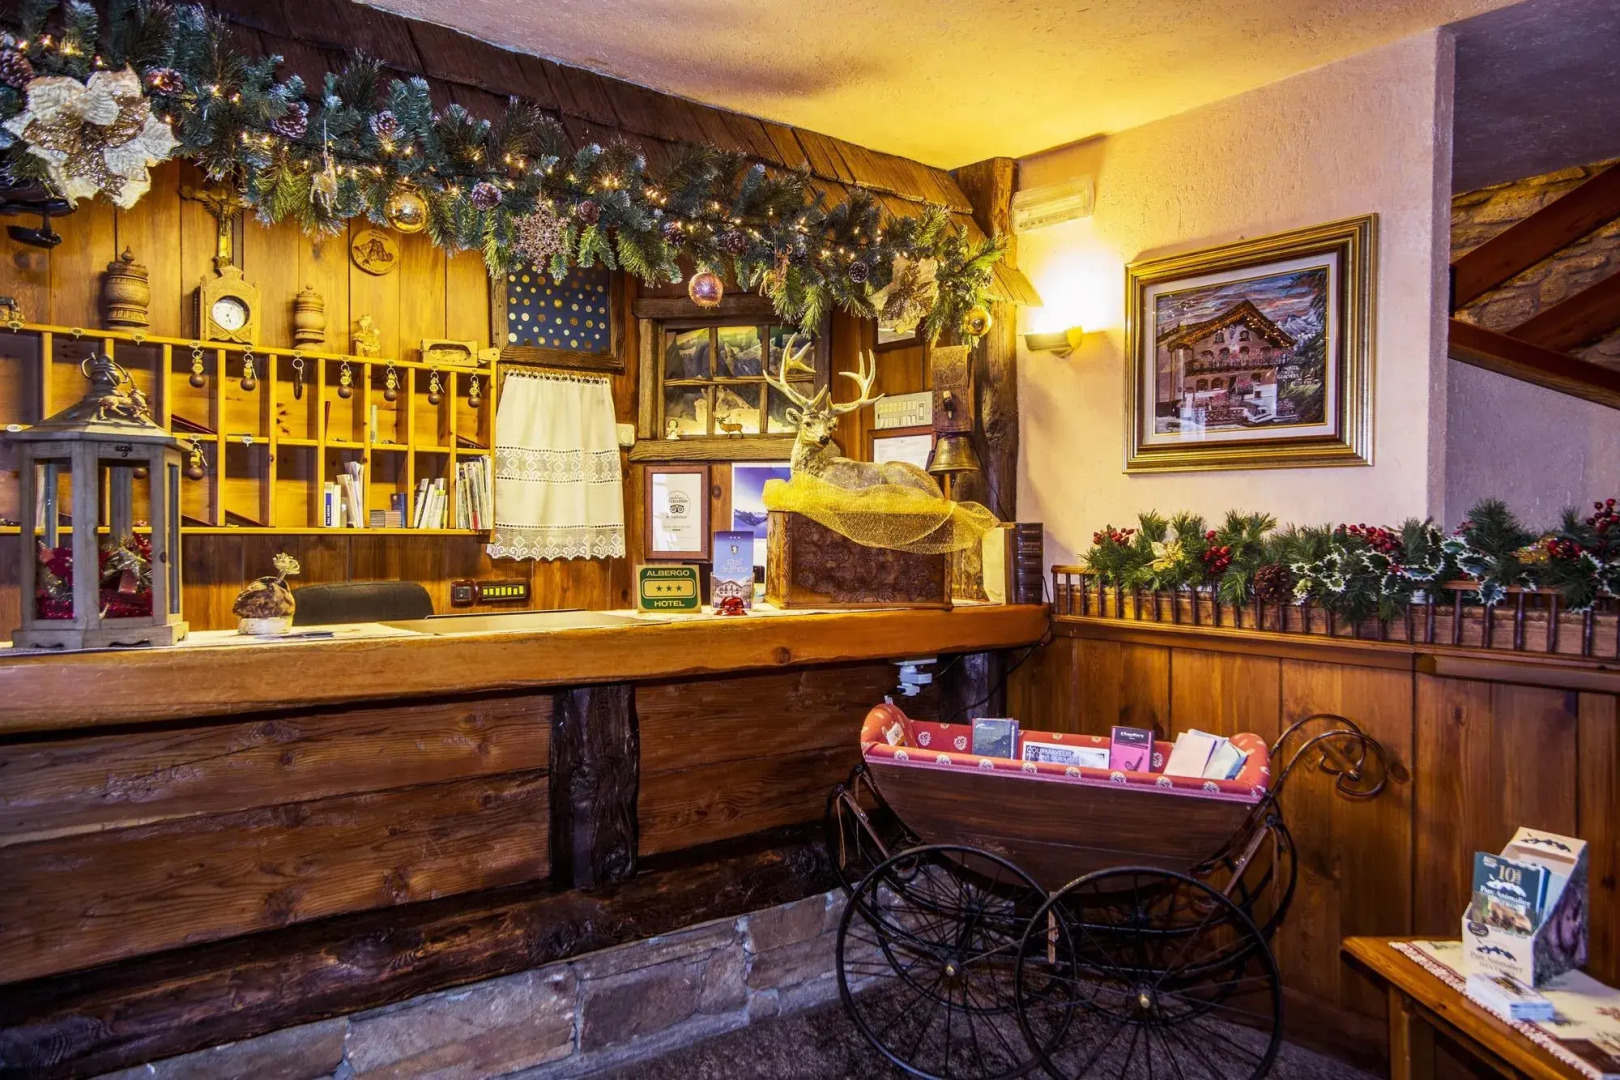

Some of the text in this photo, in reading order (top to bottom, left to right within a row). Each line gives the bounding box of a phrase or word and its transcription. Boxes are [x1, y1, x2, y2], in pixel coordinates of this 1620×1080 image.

[646, 569, 690, 577] ALBERGO
[1026, 746, 1072, 757] COURMAYEUR
[1498, 865, 1516, 883] 10
